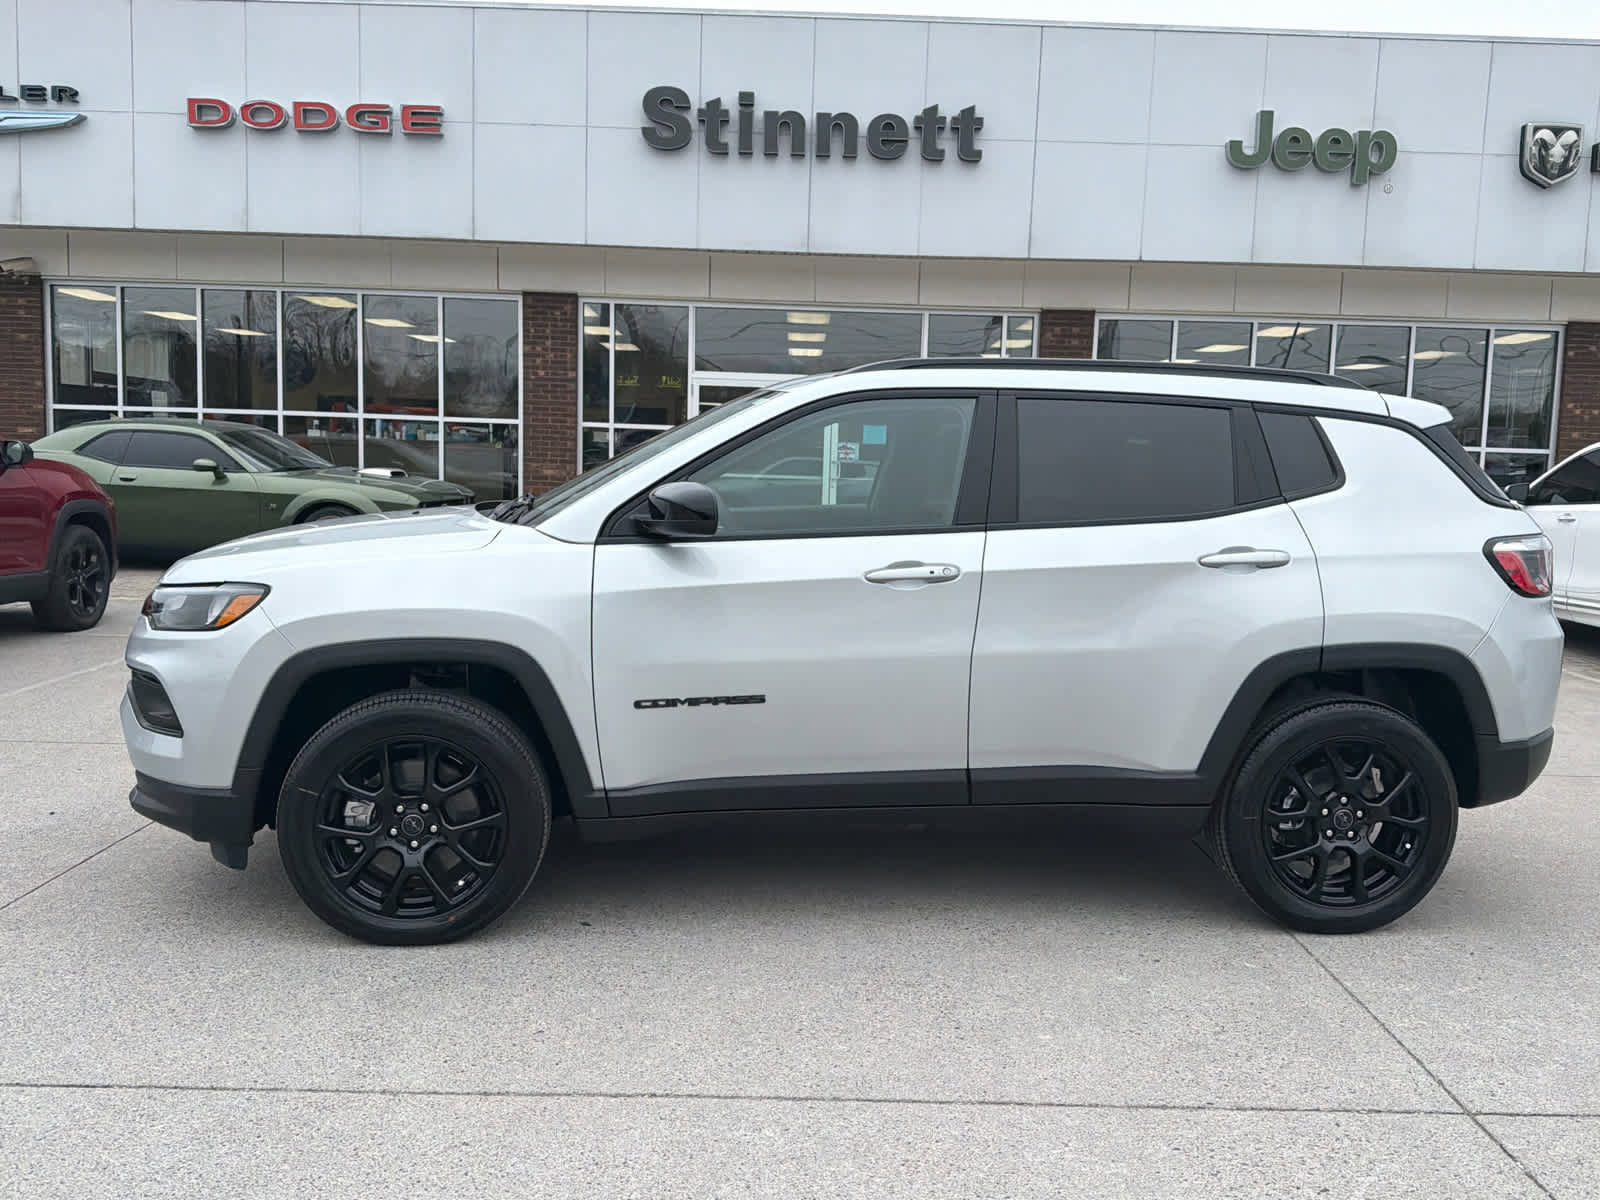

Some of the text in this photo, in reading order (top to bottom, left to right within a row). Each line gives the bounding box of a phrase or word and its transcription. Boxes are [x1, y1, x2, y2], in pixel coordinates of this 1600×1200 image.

[187, 98, 444, 136] DODGE
[641, 85, 984, 162] Stinnett
[1225, 110, 1398, 185] Jeep
[633, 694, 767, 710] COMPASS
